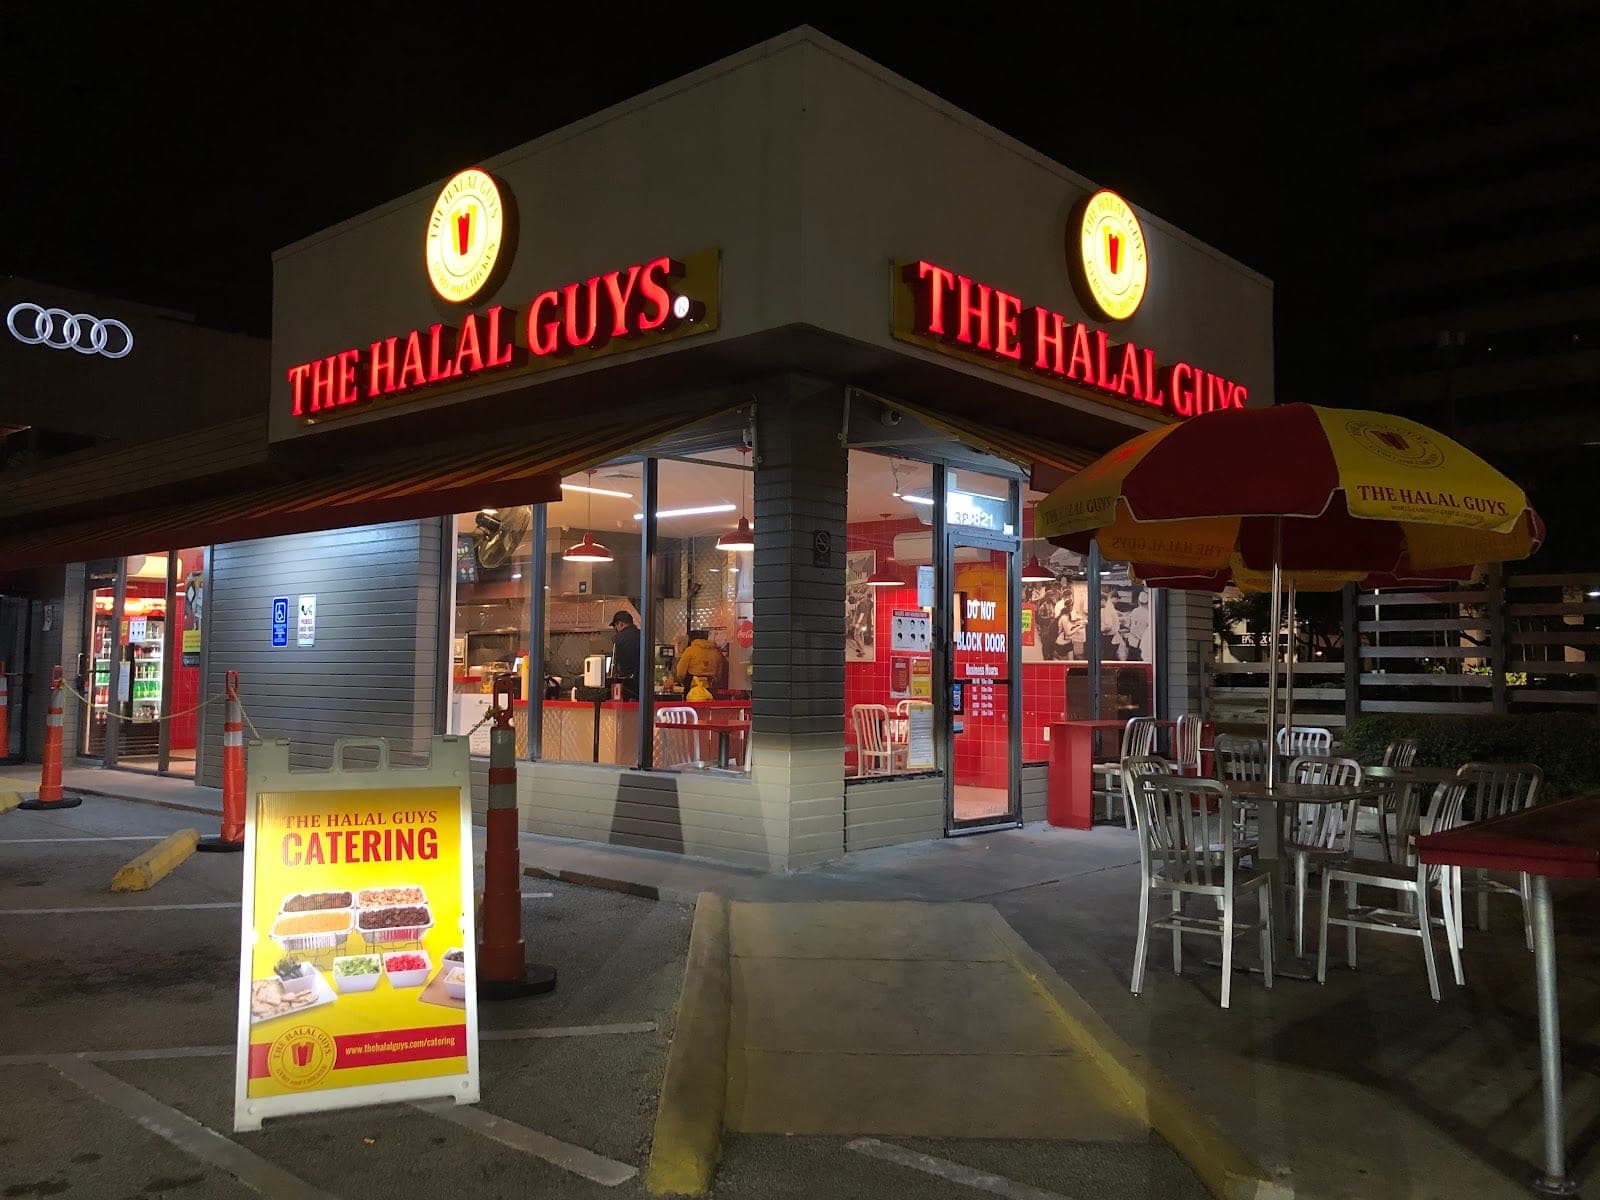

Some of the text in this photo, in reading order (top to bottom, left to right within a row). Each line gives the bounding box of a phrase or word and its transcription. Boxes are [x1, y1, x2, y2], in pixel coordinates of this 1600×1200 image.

[918, 259, 1023, 361] THE
[1034, 305, 1164, 407] HALAL
[286, 349, 359, 416] THE
[367, 305, 513, 398] HALAL
[1356, 484, 1398, 502] THE
[1399, 488, 1461, 508] HALAL
[966, 599, 996, 621] DO NOT
[956, 631, 1006, 653] BLOCK DOOR
[284, 810, 437, 829] THE HALAL GUYS
[281, 827, 438, 867] CATERING
